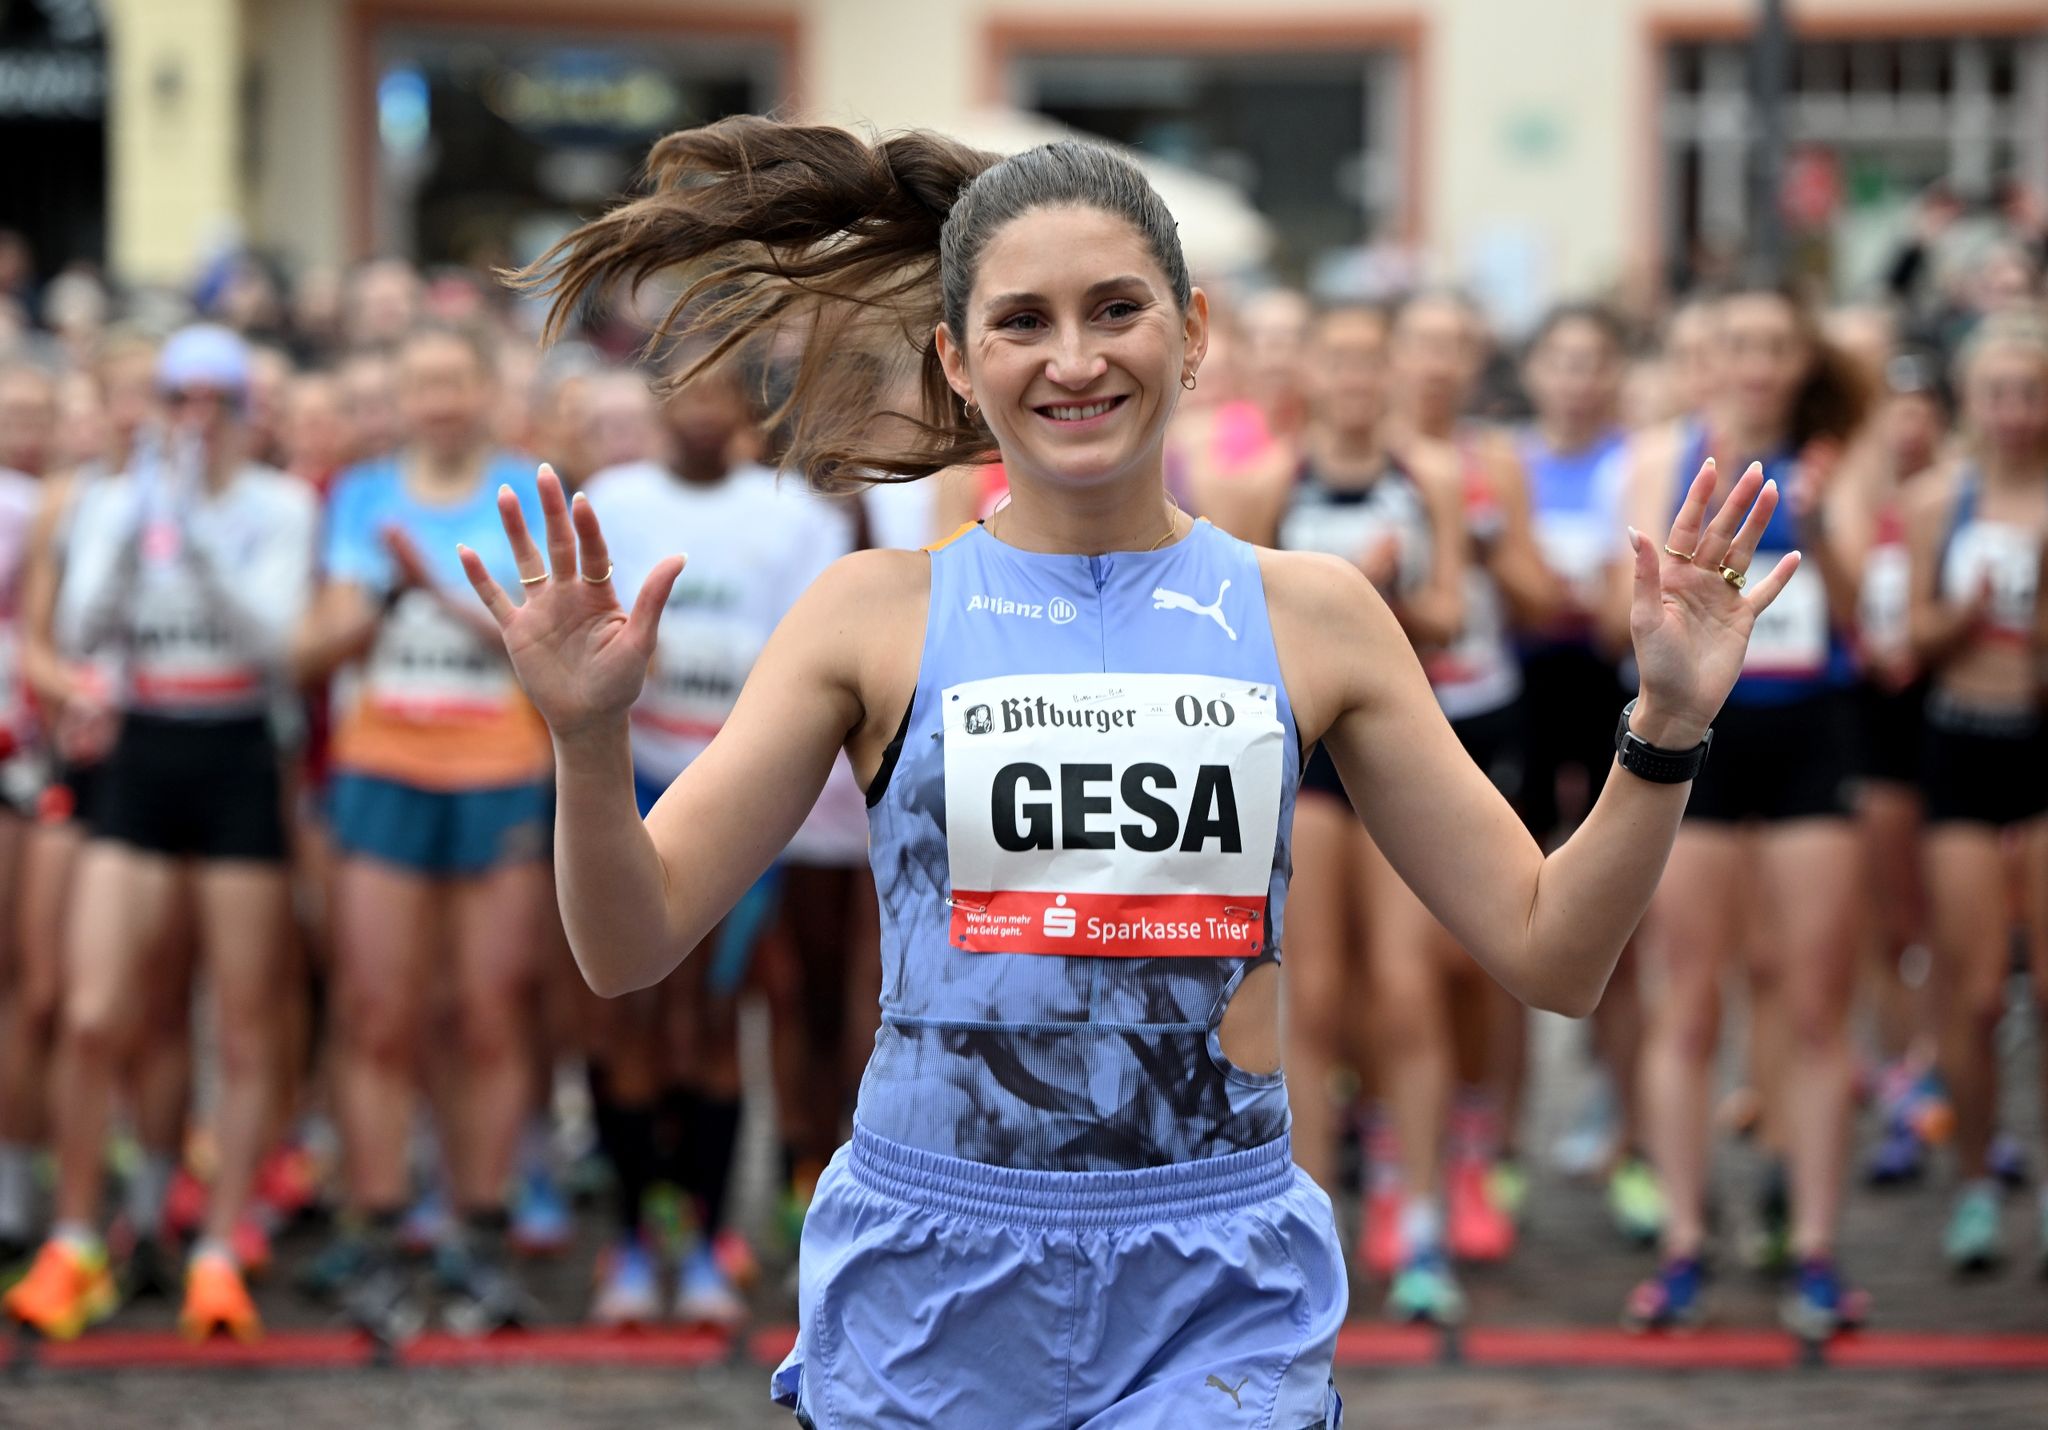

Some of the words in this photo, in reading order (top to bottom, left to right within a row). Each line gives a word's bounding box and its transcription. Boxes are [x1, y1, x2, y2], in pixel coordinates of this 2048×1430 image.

[966, 594, 1043, 618] Allianz
[1002, 696, 1136, 733] Bitburger
[1175, 694, 1235, 727] 0.0
[991, 762, 1242, 853] GESA
[966, 925, 978, 935] als
[979, 925, 999, 935] Geld
[1000, 926, 1022, 938] geht.
[994, 915, 1007, 923] um
[1008, 914, 1031, 924] mehr
[1087, 917, 1200, 944] Sparkasse
[1205, 917, 1249, 940] Trier
